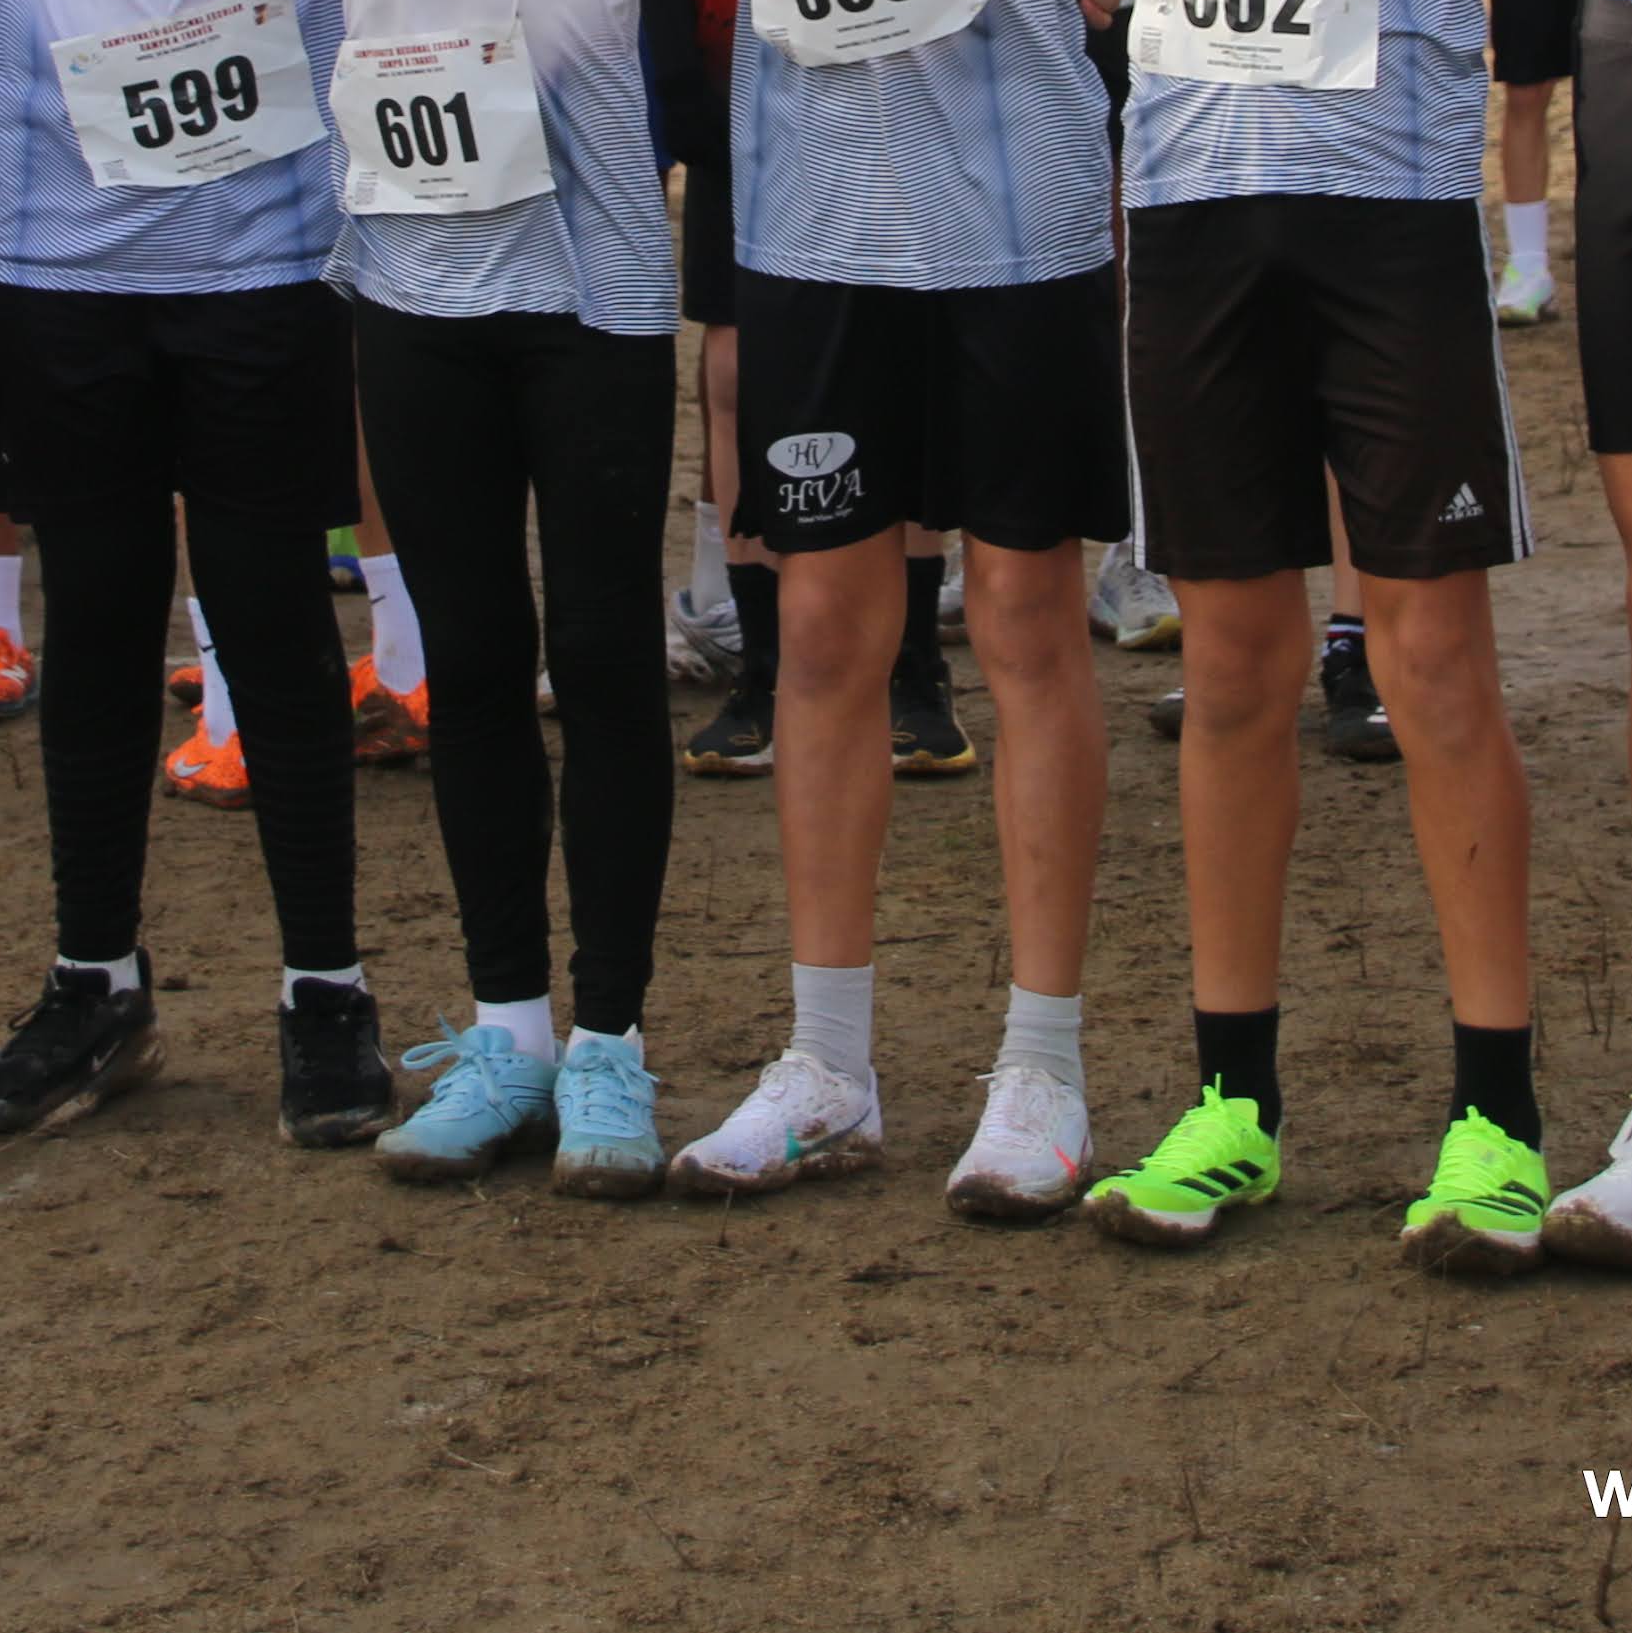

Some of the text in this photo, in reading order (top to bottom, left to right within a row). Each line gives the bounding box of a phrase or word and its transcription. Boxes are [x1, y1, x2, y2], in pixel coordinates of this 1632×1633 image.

[122, 55, 260, 150] 599
[375, 91, 480, 169] 601
[779, 467, 867, 513] HVA
